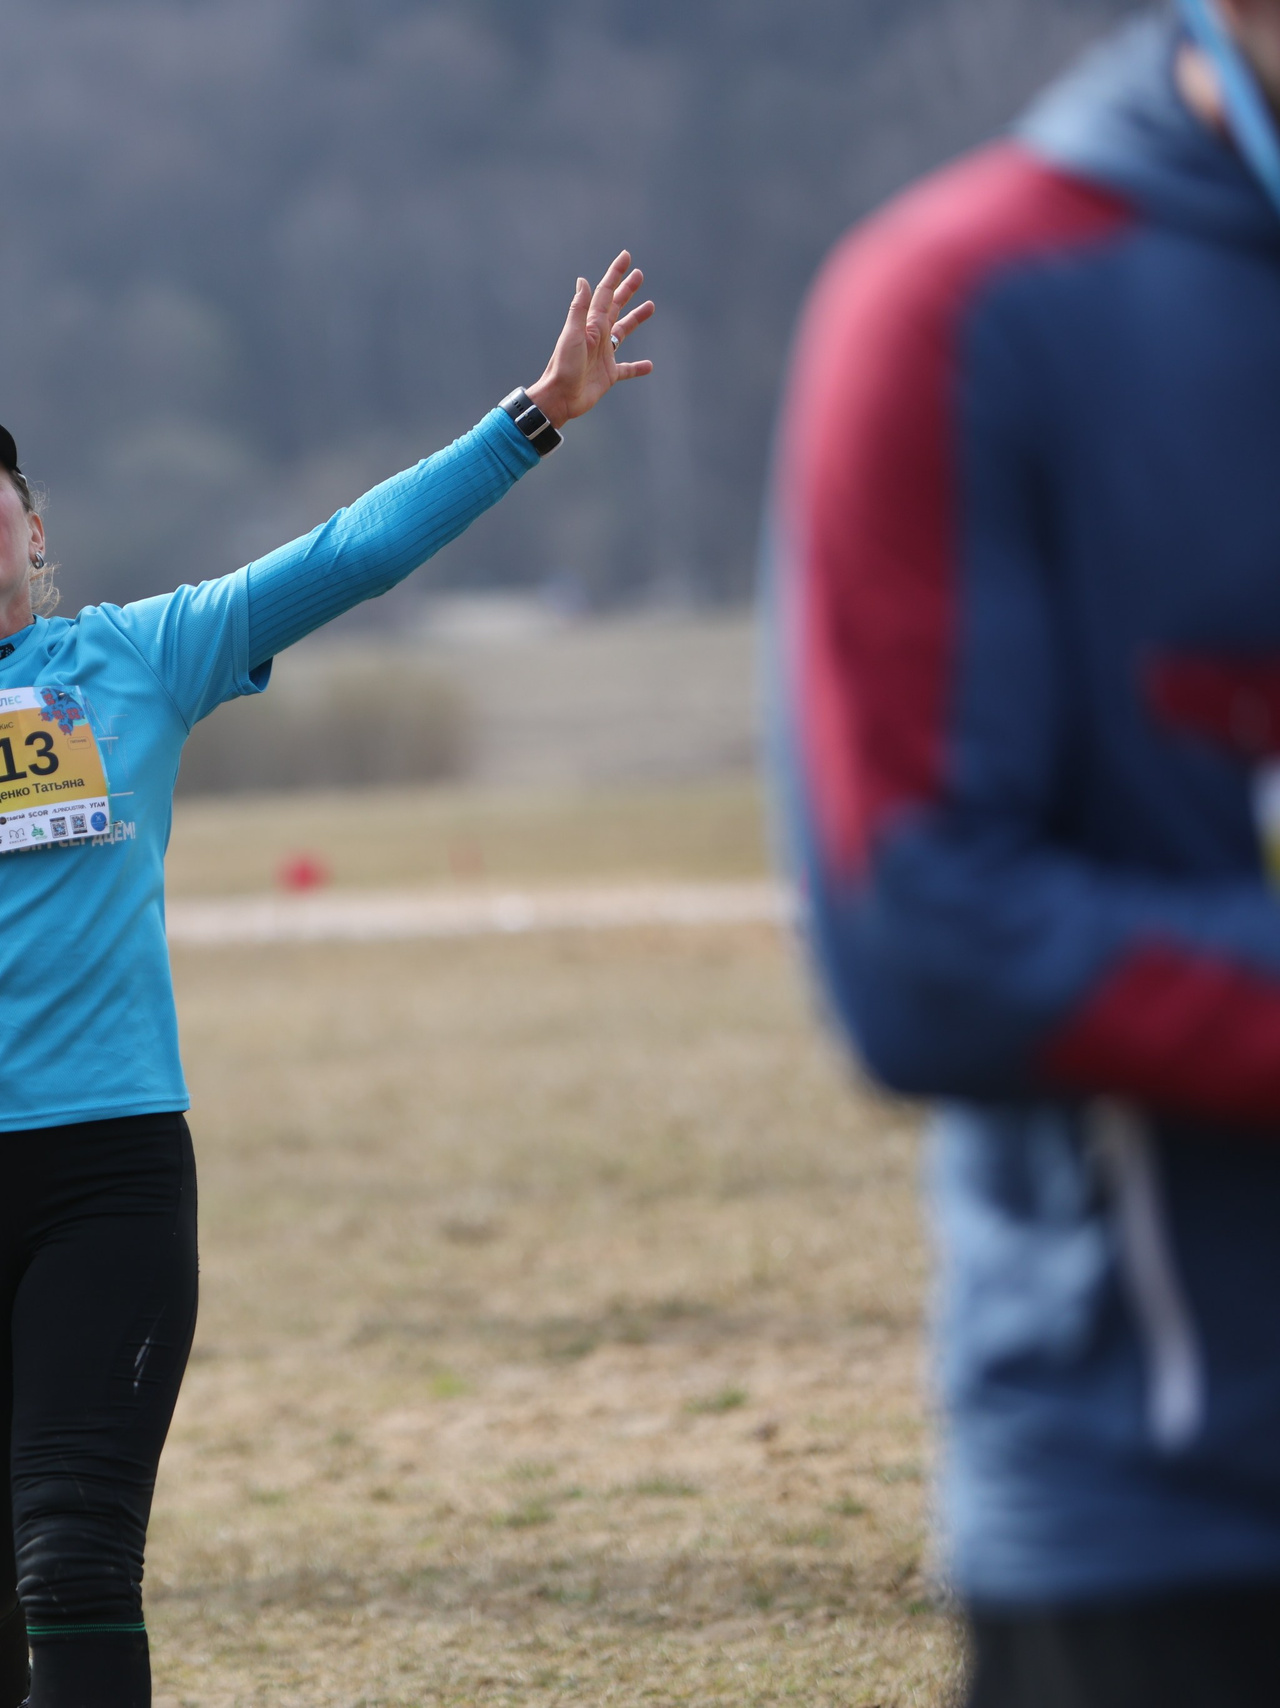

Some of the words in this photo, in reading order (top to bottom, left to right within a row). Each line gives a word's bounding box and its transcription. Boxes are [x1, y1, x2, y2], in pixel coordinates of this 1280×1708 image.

[0, 695, 22, 707] ЛЕС
[32, 778, 85, 794] Татьяна
[28, 810, 49, 819] SCOR
